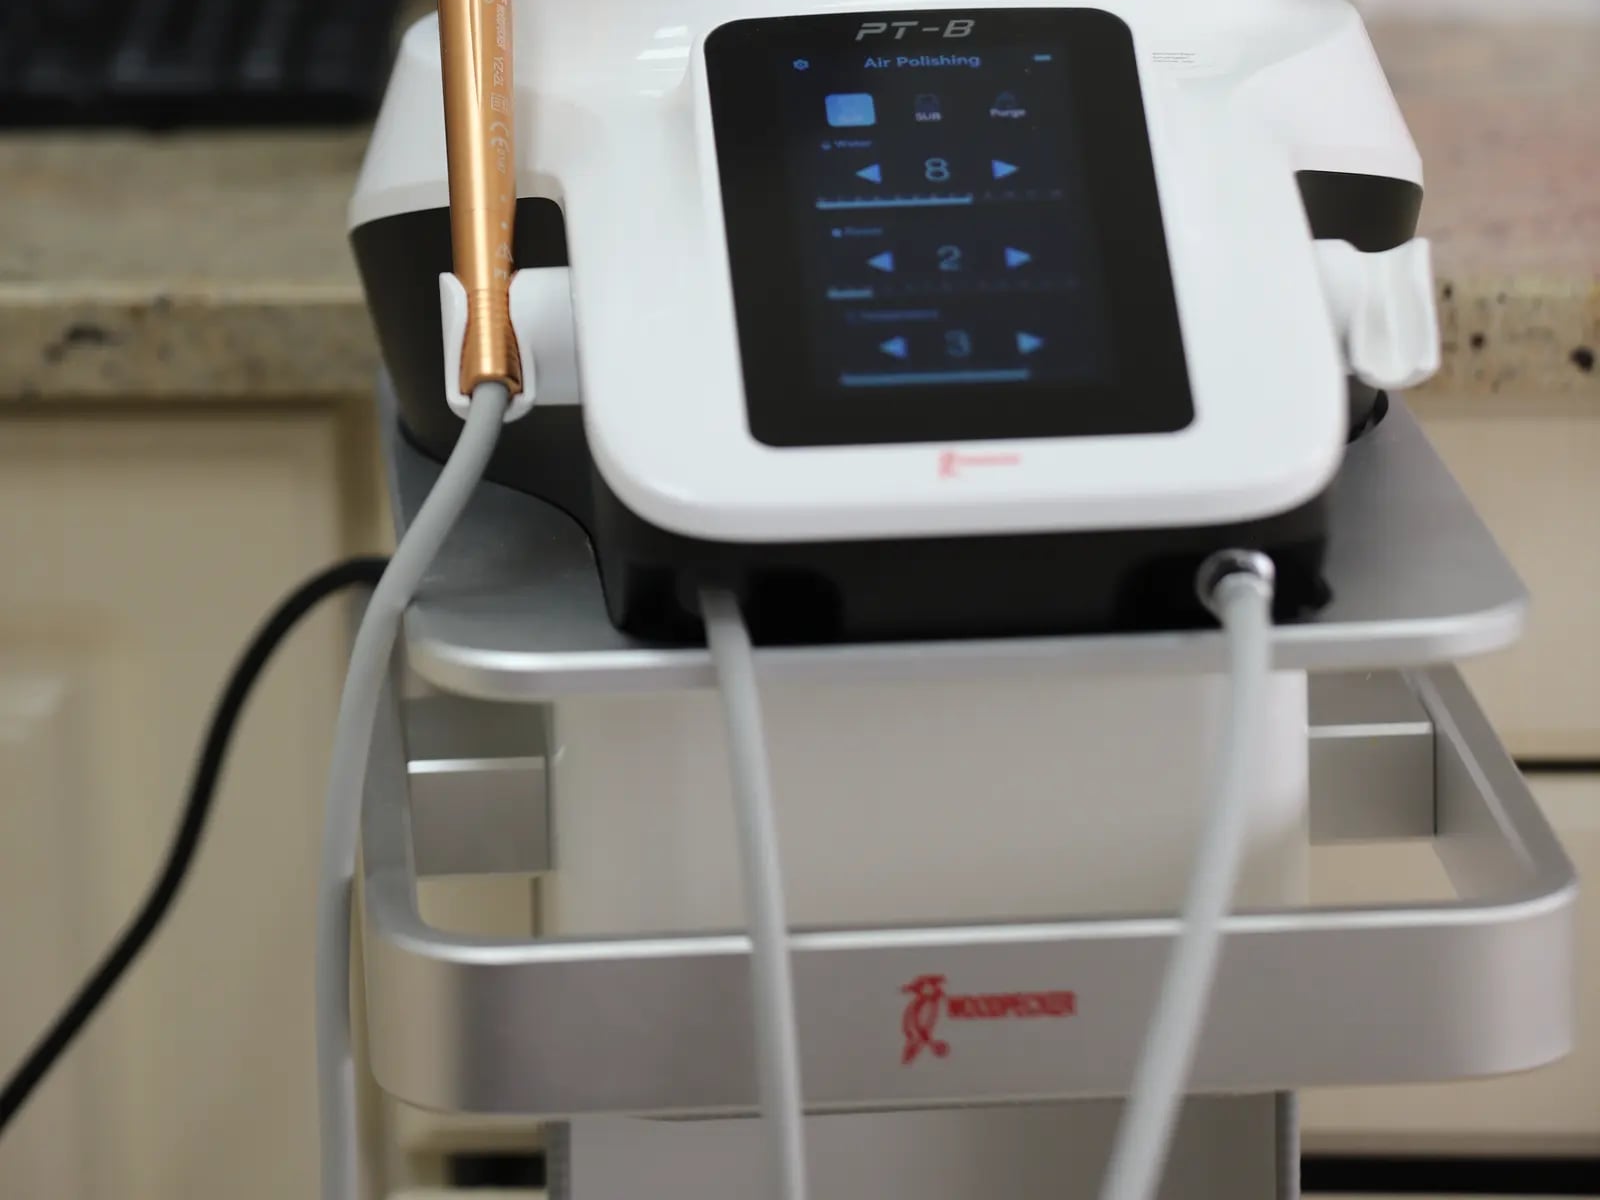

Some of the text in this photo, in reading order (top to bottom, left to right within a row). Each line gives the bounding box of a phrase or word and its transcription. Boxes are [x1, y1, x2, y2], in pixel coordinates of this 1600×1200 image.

[854, 19, 976, 41] PT-B
[864, 54, 981, 70] Air Polishing
[924, 157, 950, 183] 8
[936, 245, 962, 271] 2
[944, 330, 972, 358] 3
